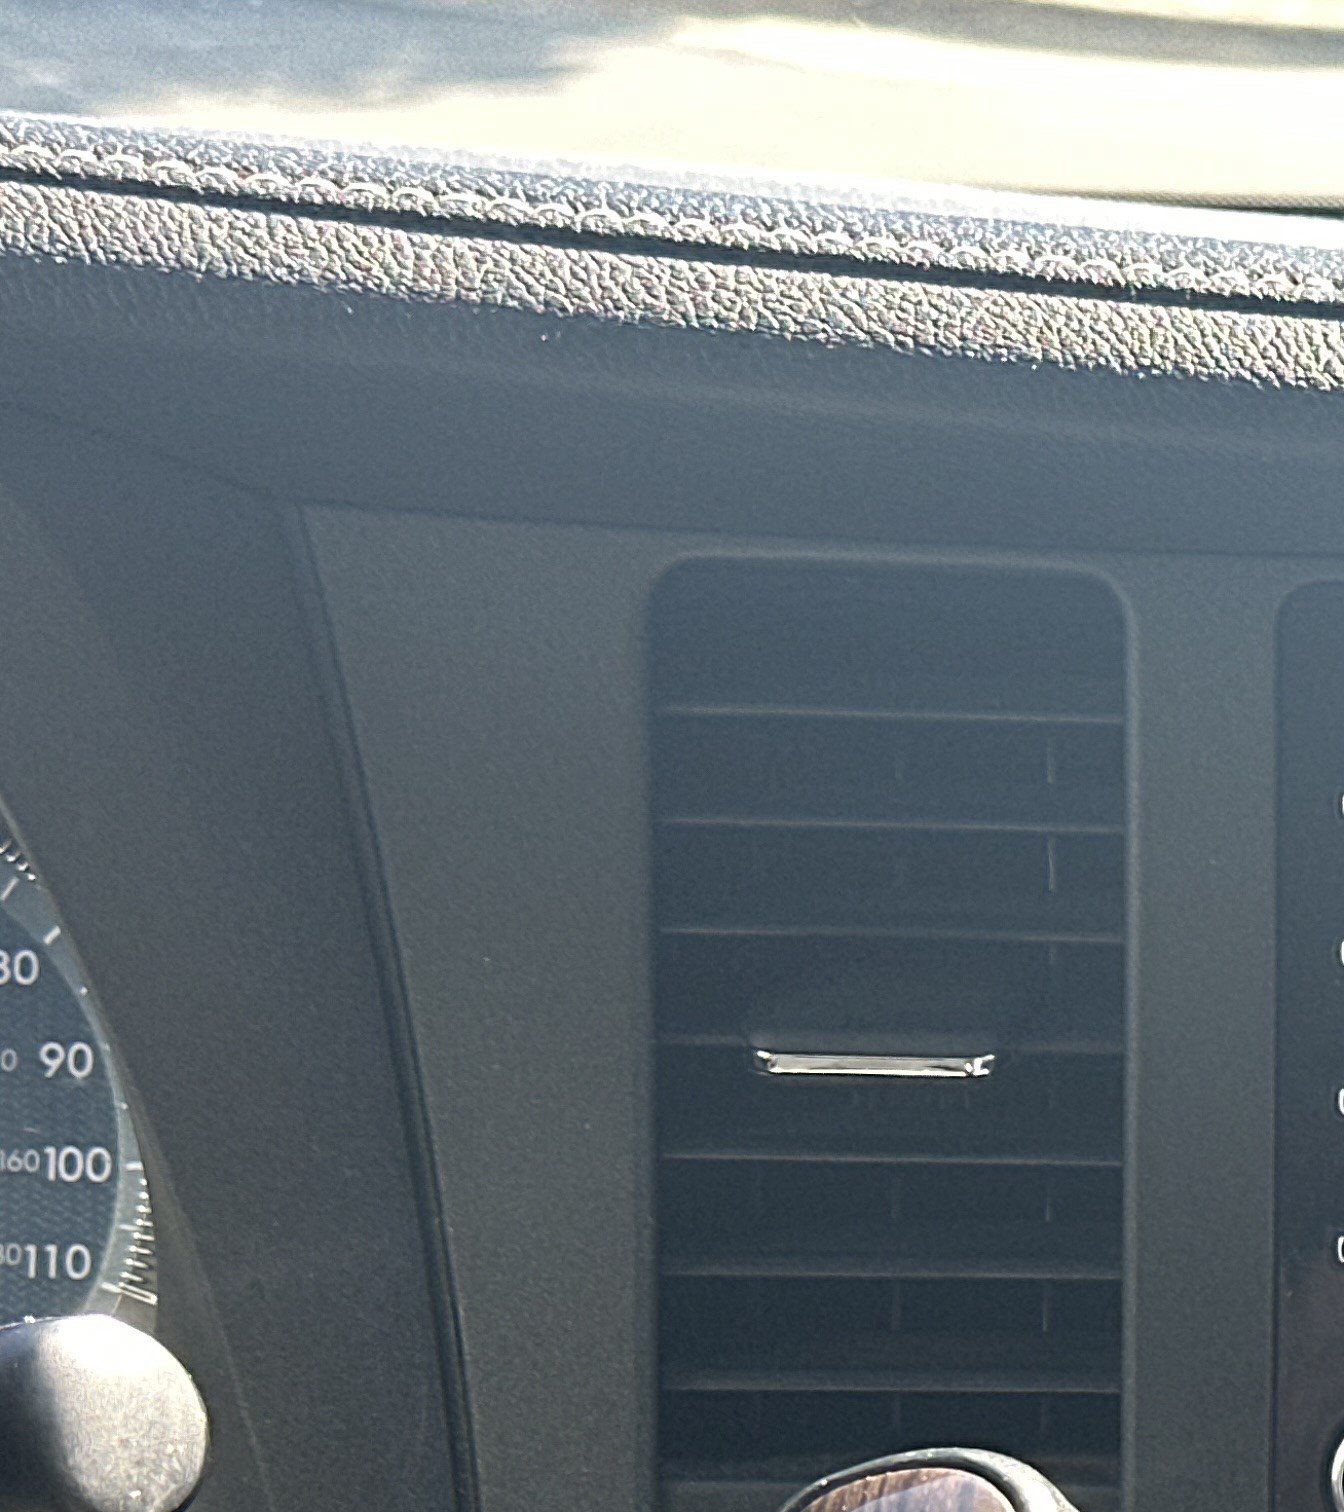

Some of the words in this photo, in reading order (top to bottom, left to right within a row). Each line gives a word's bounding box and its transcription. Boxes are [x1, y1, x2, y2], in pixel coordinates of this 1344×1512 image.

[39, 1042, 94, 1079] 90
[43, 1145, 112, 1183] 100
[24, 1243, 92, 1281] 110
